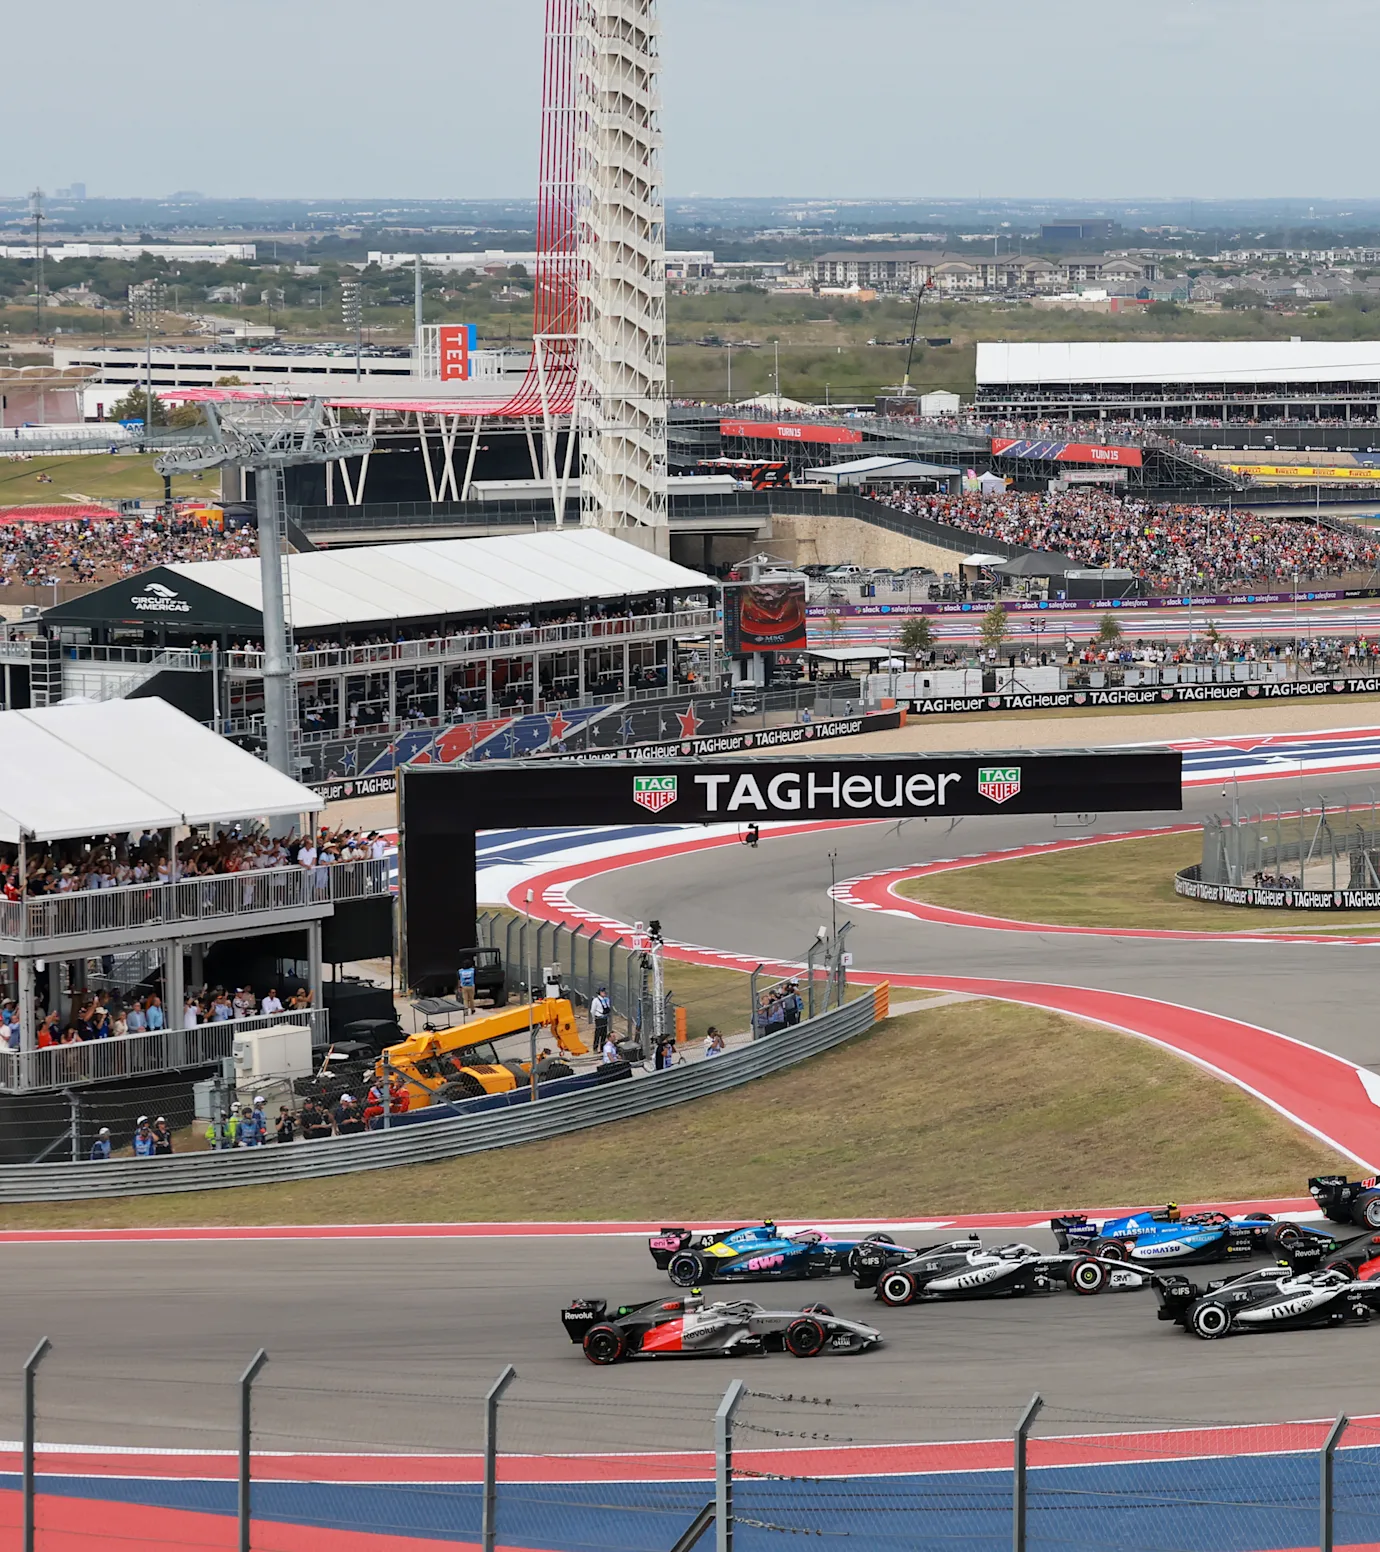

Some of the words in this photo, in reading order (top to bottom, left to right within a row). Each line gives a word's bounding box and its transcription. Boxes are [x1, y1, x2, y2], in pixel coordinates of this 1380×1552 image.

[1091, 447, 1110, 459] TURN
[1111, 449, 1119, 460] 15
[131, 597, 171, 605] CIRCUIT
[1048, 601, 1077, 610] salesforce
[1096, 600, 1113, 608] slack
[1122, 600, 1148, 609] salesforce
[1167, 598, 1181, 606] slack
[1191, 597, 1216, 605] salesforce
[136, 604, 190, 612] AMERICAS
[809, 606, 840, 615] salesforce
[891, 605, 922, 613] salesforce
[1176, 687, 1244, 700] TAGHeuer
[1263, 682, 1330, 696] TAGHeuer
[1003, 693, 1073, 709] TAGHeuer
[1090, 690, 1159, 705] TAGHeuer
[913, 698, 985, 713] TAGHeuer
[816, 720, 862, 737] TAGHeuer
[755, 728, 803, 746] TAGHeuer
[693, 736, 743, 753] TAGHeuer
[982, 770, 1017, 781] TAG
[355, 779, 396, 794] TAGHeu
[638, 778, 673, 790] TAG
[694, 771, 962, 812] TAGHeuer
[980, 783, 1019, 802] HEUER
[636, 791, 676, 811] HEUER
[1223, 887, 1247, 904] TAGHeuer
[1253, 890, 1285, 906] TAGHeuer
[1293, 891, 1332, 908] TAGHeuer
[1361, 1177, 1376, 1188] 41
[1068, 1225, 1094, 1233] KOMATSU
[1113, 1226, 1157, 1237] ATLASSIAN
[701, 1236, 714, 1247] 43
[1140, 1244, 1181, 1255] KOMATSU
[1295, 1248, 1320, 1257] Revolut
[748, 1254, 784, 1271] BWT
[867, 1256, 880, 1265] IFS
[1113, 1274, 1128, 1282] 3M
[1178, 1286, 1190, 1295] IFS
[1233, 1291, 1247, 1299] 77
[564, 1311, 593, 1320] Revolut
[683, 1326, 716, 1341] Revolut
